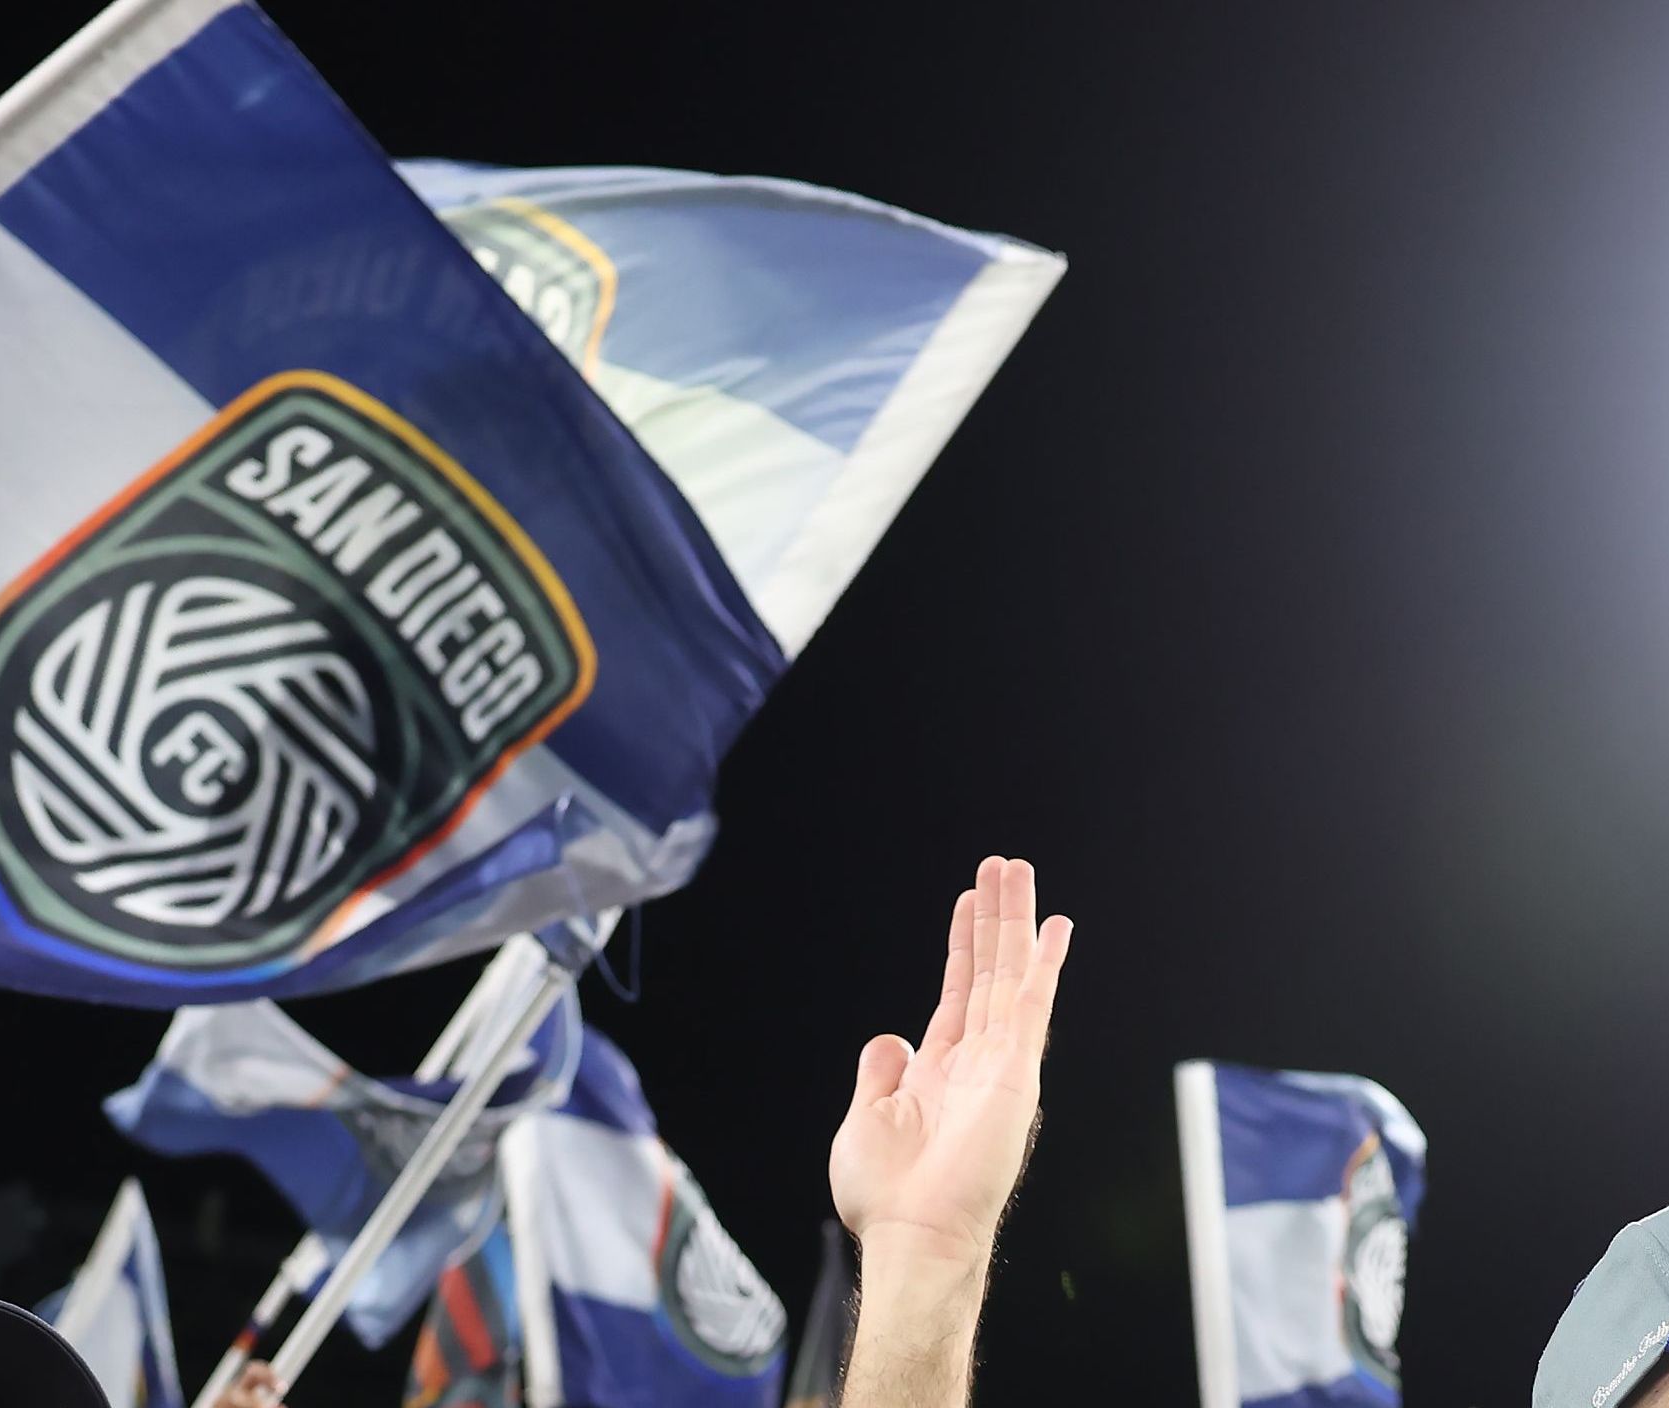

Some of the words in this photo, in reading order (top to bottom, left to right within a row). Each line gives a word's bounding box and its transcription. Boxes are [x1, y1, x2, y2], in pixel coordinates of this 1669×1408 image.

[225, 424, 421, 578] SAN
[365, 536, 544, 742] DIEGO
[151, 710, 246, 803] FC
